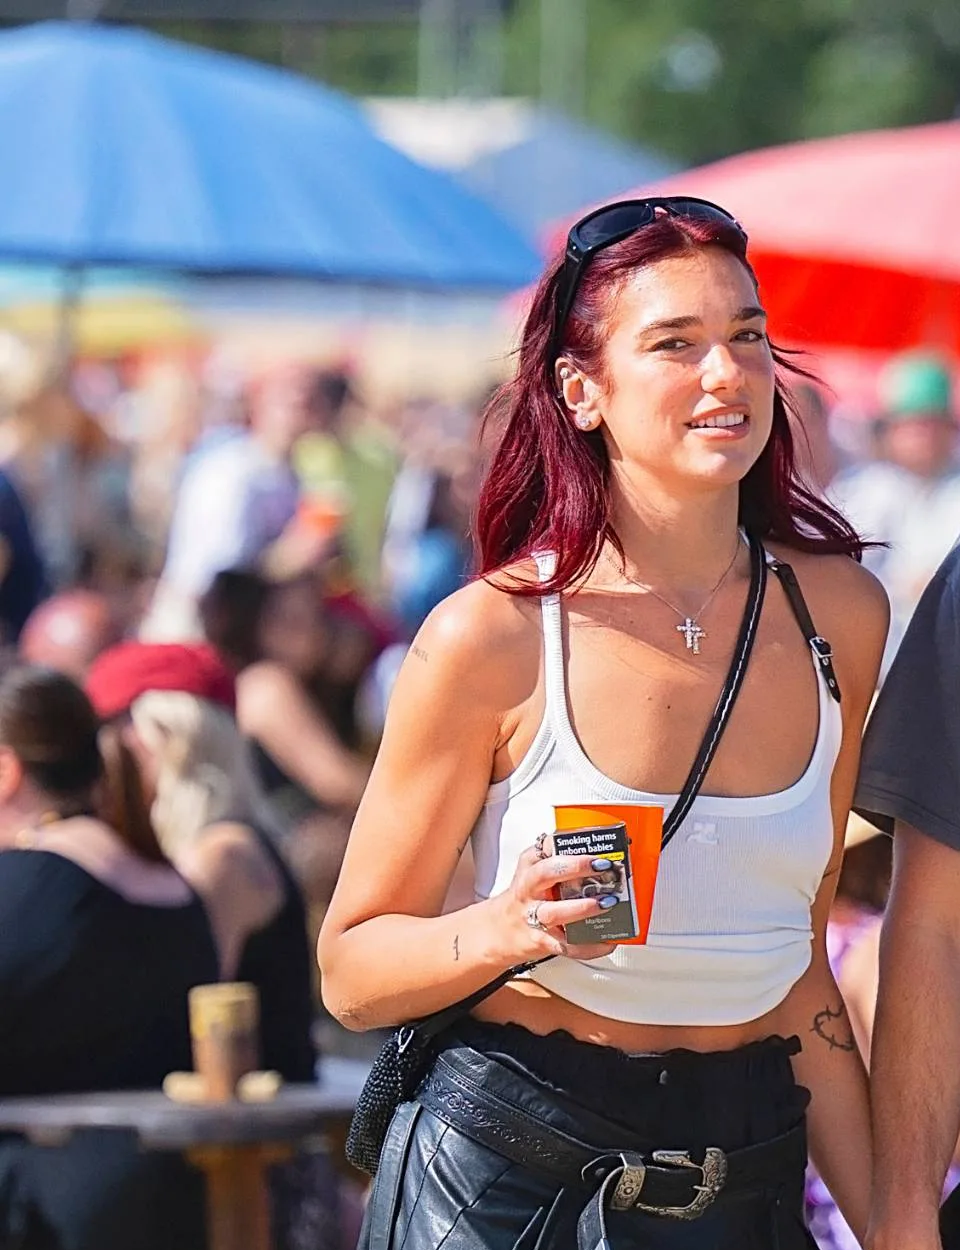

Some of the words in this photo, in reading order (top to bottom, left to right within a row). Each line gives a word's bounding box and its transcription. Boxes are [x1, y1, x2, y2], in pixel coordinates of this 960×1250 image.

[556, 835, 591, 847] Smoking
[591, 833, 617, 843] harms
[558, 845, 587, 855] unborn
[588, 843, 614, 853] babies
